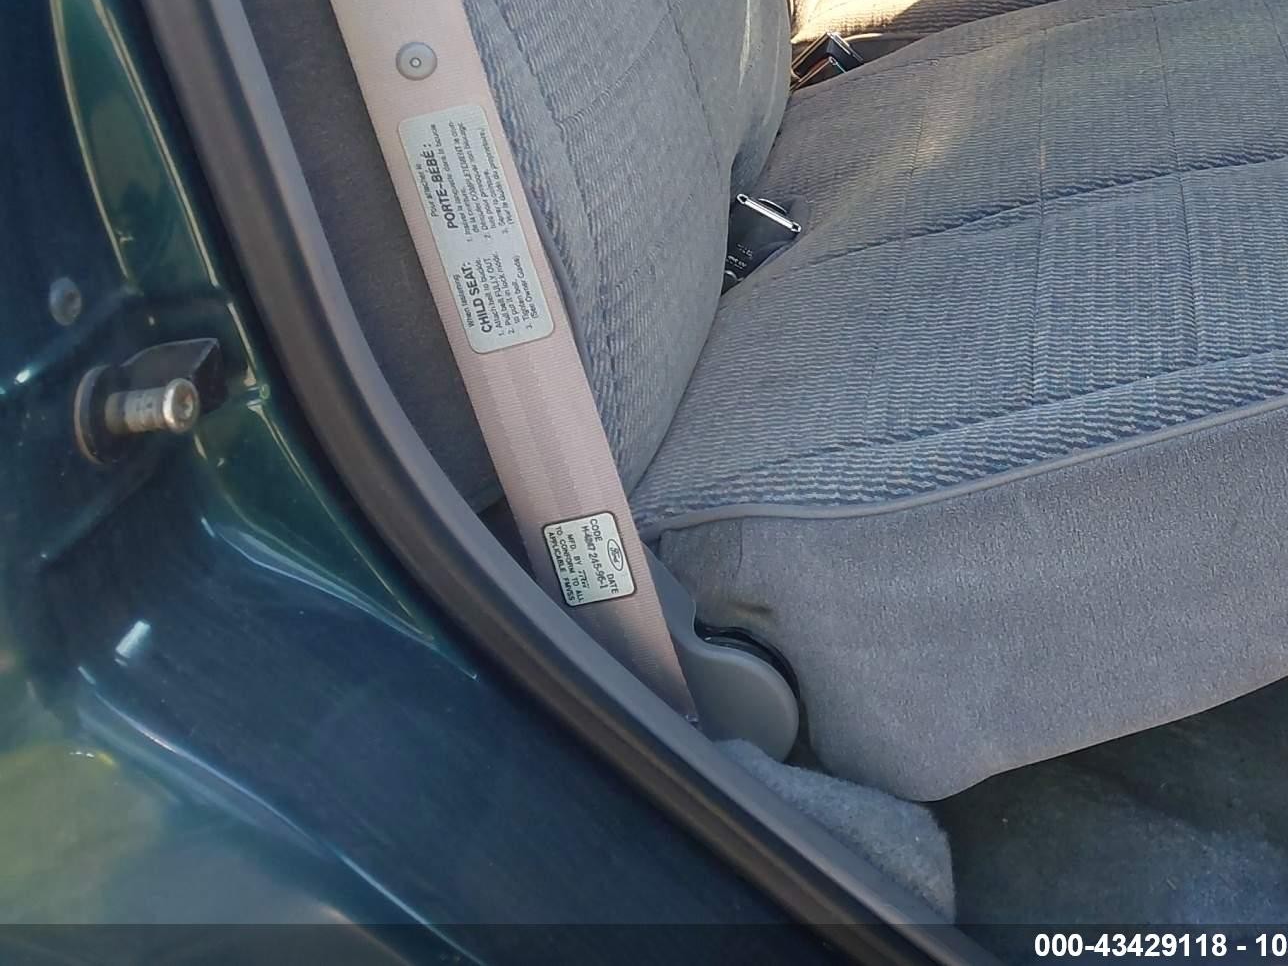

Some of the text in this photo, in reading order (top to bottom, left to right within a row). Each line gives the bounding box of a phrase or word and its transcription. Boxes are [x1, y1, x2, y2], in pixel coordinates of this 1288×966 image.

[483, 257, 494, 274] OUT
[489, 275, 503, 297] FULLY
[498, 274, 509, 289] lock
[511, 255, 538, 319] (See Owner Guide)
[452, 273, 475, 327] When fastening
[460, 261, 493, 334] CHILD SEAT:
[485, 292, 495, 305] belt
[497, 298, 507, 312] belt
[516, 295, 531, 320] Tighten
[490, 306, 502, 328] Attach
[502, 313, 512, 326] Pull
[509, 303, 519, 315] put
[548, 532, 575, 601] APPLICABLE FMVSS
[555, 526, 584, 602] TO CONFORM TO ALL
[573, 556, 582, 565] BY
[589, 518, 619, 594] CODE DATE
